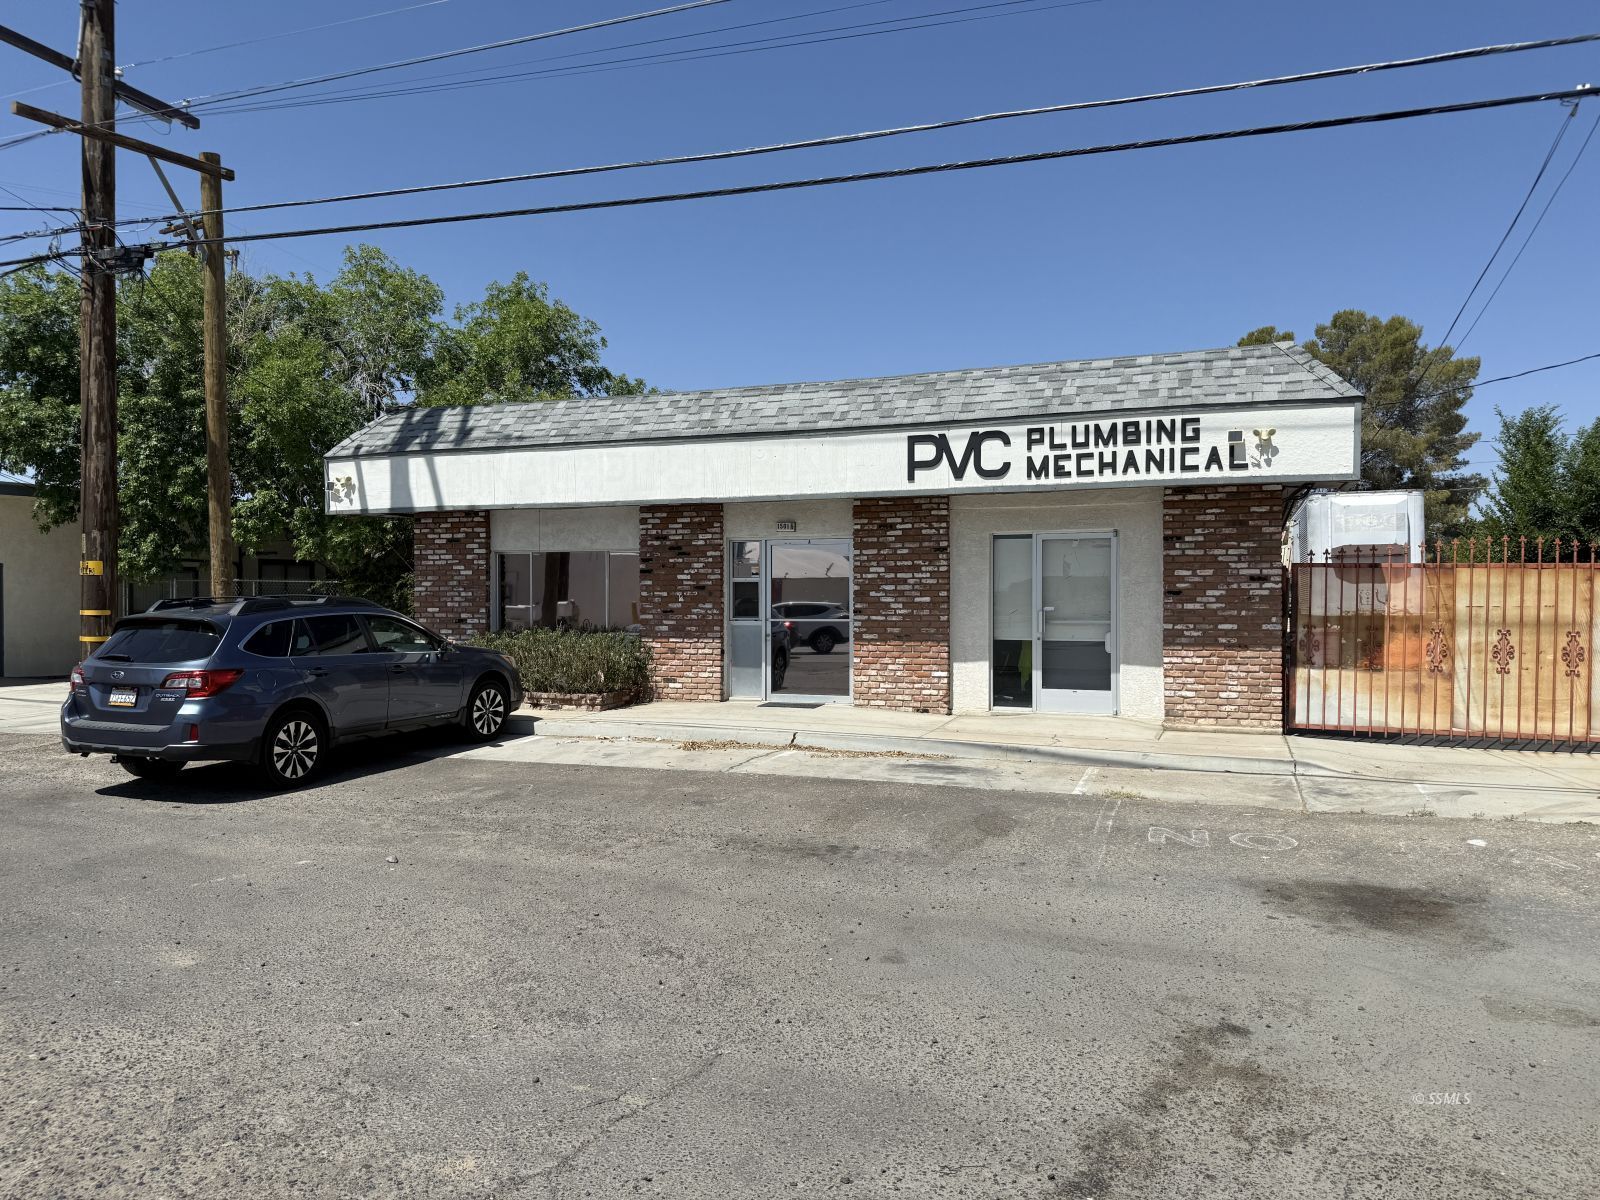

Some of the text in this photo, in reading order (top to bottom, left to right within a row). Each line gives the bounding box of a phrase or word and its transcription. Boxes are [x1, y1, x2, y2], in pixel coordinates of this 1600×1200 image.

[1026, 417, 1200, 451] PLUMBING
[907, 430, 1011, 482] PVC
[1026, 445, 1249, 480] MECHANICAL
